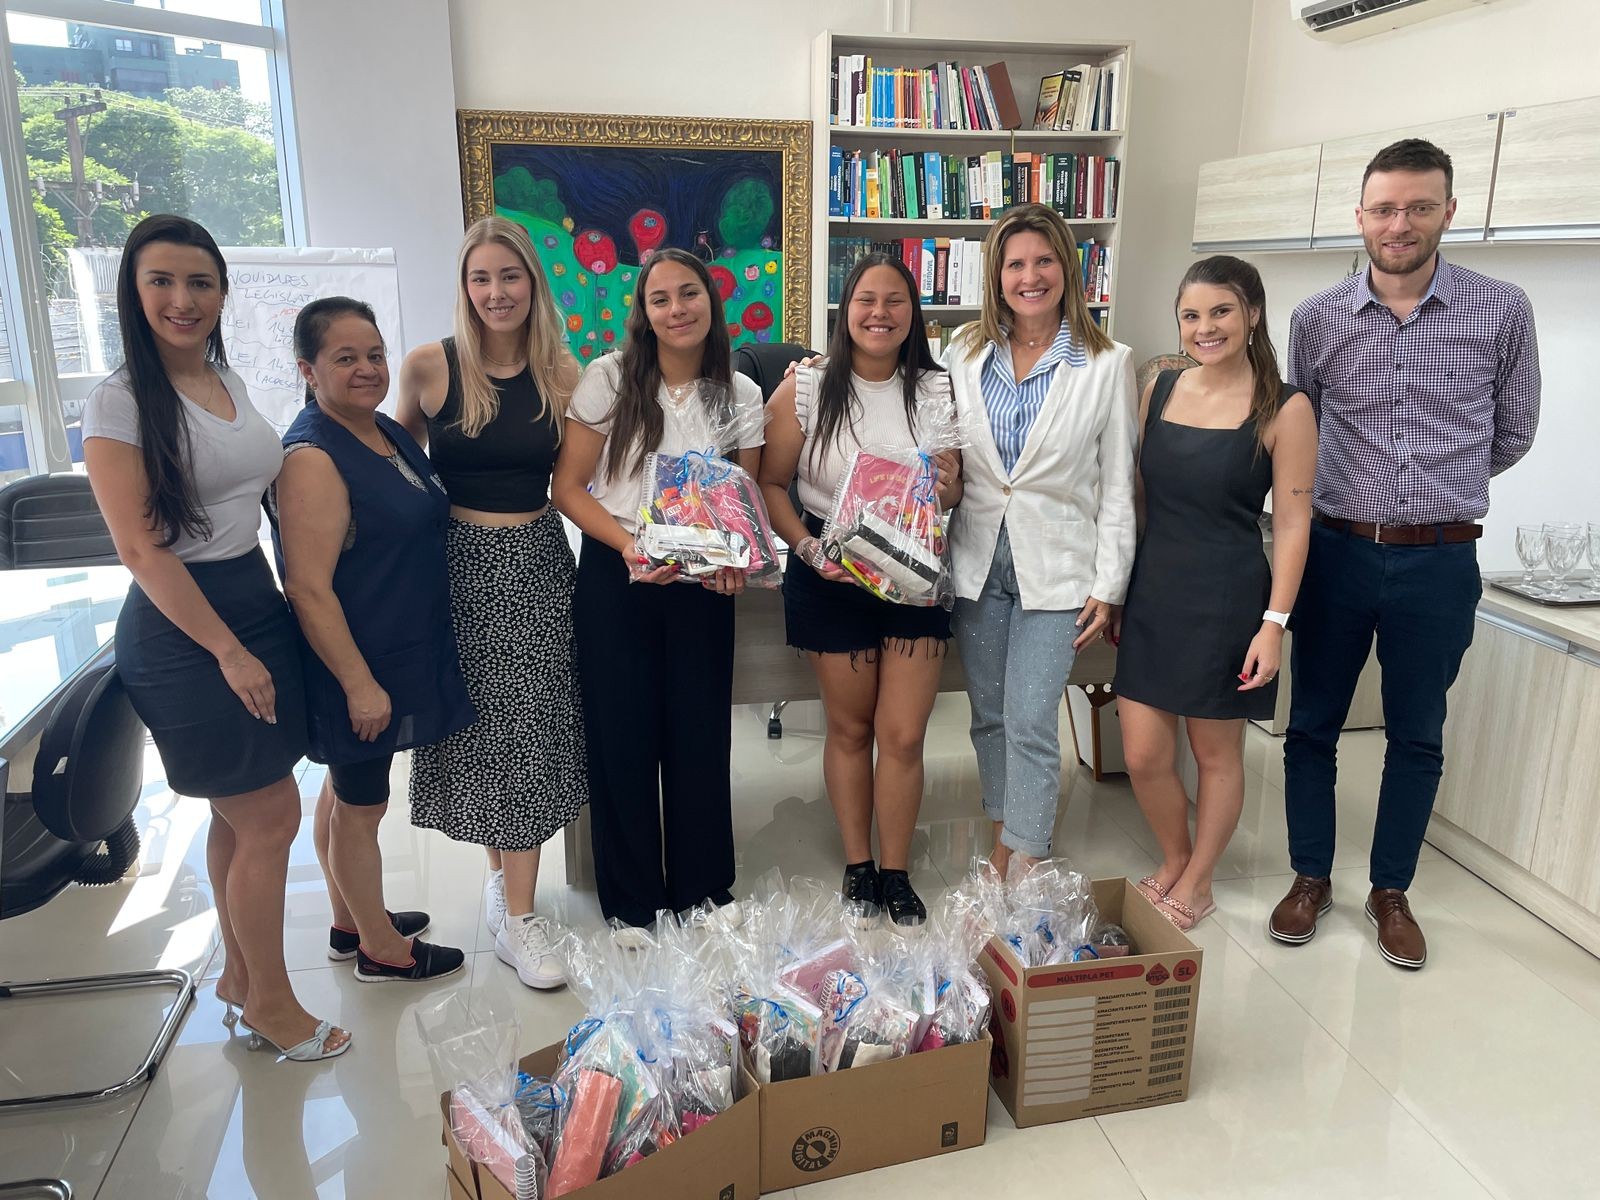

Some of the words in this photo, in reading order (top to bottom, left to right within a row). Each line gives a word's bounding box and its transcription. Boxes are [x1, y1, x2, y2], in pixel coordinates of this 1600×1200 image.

[1099, 971, 1115, 980] PET
[1178, 967, 1192, 976] 5L
[804, 1129, 838, 1159] MAGNUM
[795, 1144, 823, 1169] DIGITAL
